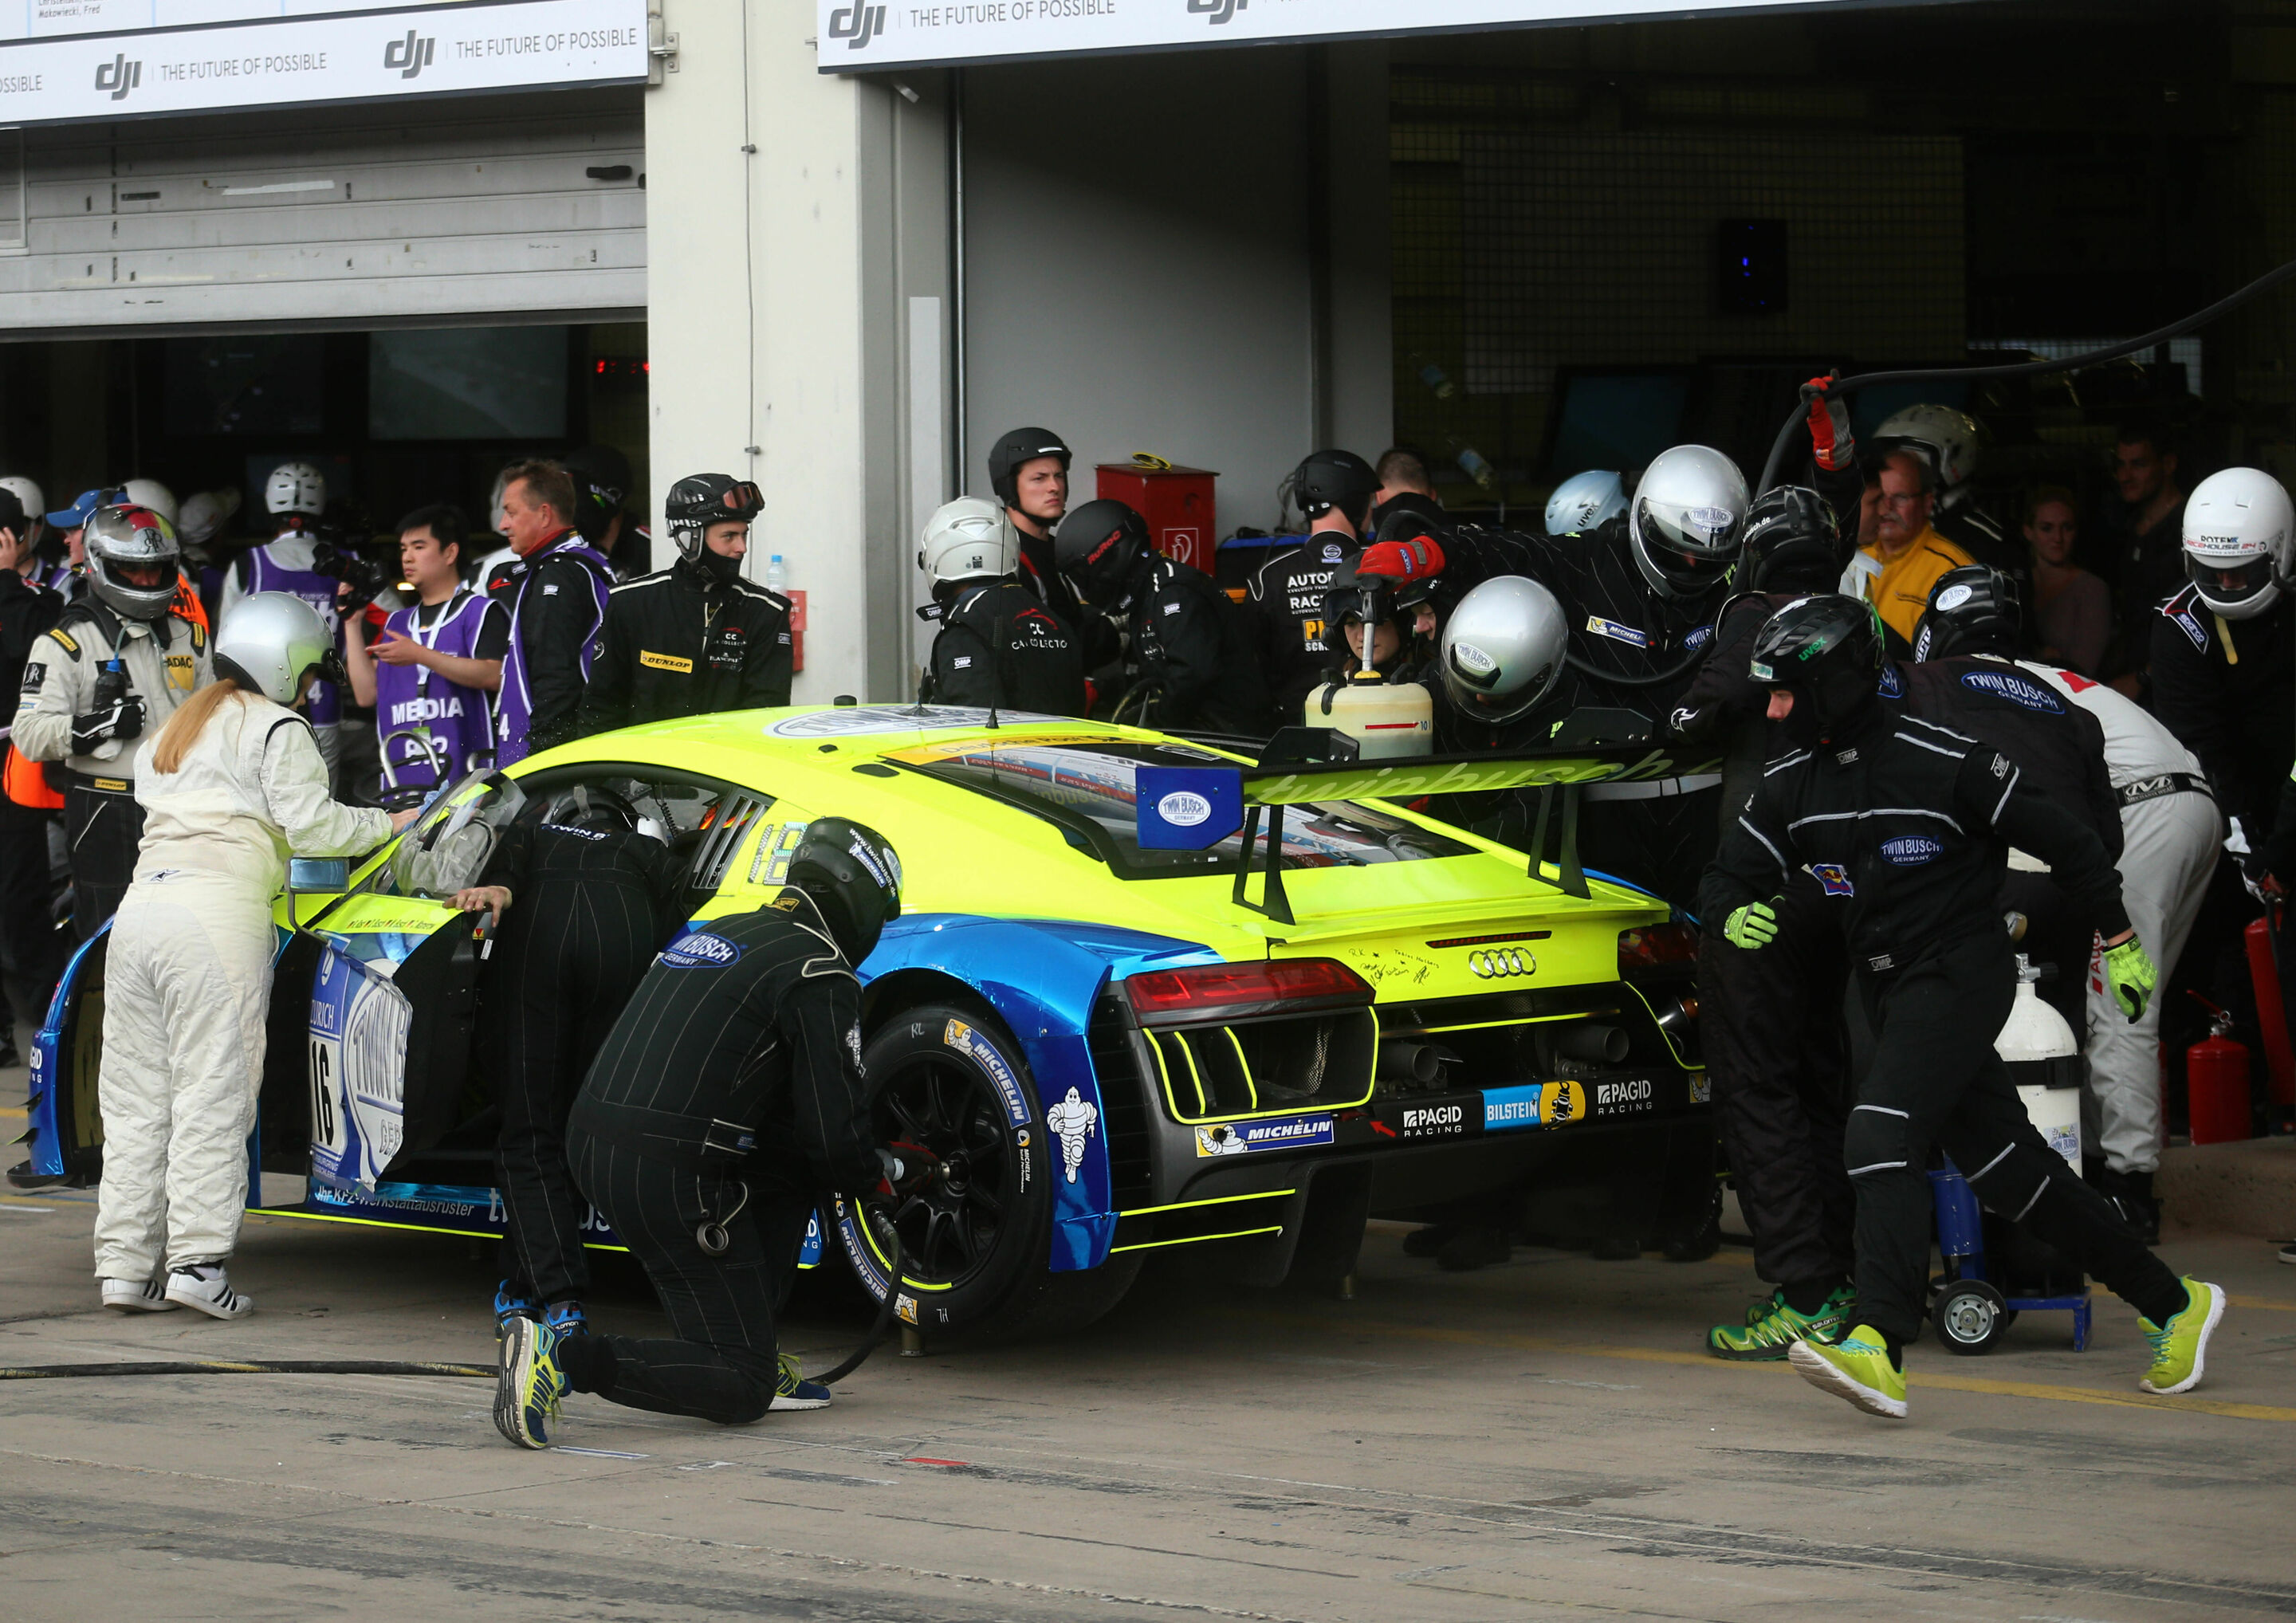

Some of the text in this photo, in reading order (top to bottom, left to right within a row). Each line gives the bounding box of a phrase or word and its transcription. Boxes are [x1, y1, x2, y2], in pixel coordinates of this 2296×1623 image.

[84, 5, 100, 14] Fred
[910, 0, 1116, 27] THE FUTURE OF POSSIBLE
[456, 28, 637, 58] THE FUTURE OF POSSIBLE
[161, 53, 327, 81] THE FUTURE OF POSSIBLE
[1165, 604, 1181, 614] OMP
[1799, 636, 1828, 662] uvex
[647, 657, 691, 668] DUNLOP
[954, 658, 971, 668] OMP
[1966, 674, 2059, 709] TWIN BUSCH
[1997, 690, 2042, 709] GERMANY
[391, 697, 464, 726] MEDIA
[1838, 751, 1858, 763] OMP
[1994, 754, 2006, 777] OMP
[1163, 798, 1205, 815] TWIN BUSCH
[1881, 839, 1940, 855] TWIN BUSCH
[849, 827, 897, 898] www.twinbusch.de
[859, 853, 886, 886] MICHELIN
[683, 934, 733, 961] BUSCH
[1871, 957, 1892, 969] OMP
[911, 1022, 926, 1039] RL
[973, 1042, 1025, 1121] MICHELIN
[1611, 1079, 1651, 1103] PAGID
[311, 1039, 335, 1146] 16
[1418, 1106, 1462, 1126] PAGID
[1487, 1102, 1539, 1122] BILSTEIN
[1598, 1101, 1653, 1116] RACING
[1247, 1121, 1331, 1141] MICHELIN
[1404, 1125, 1463, 1138] RACING
[317, 1185, 332, 1201] Ihr
[841, 1226, 887, 1301] MICHELIN
